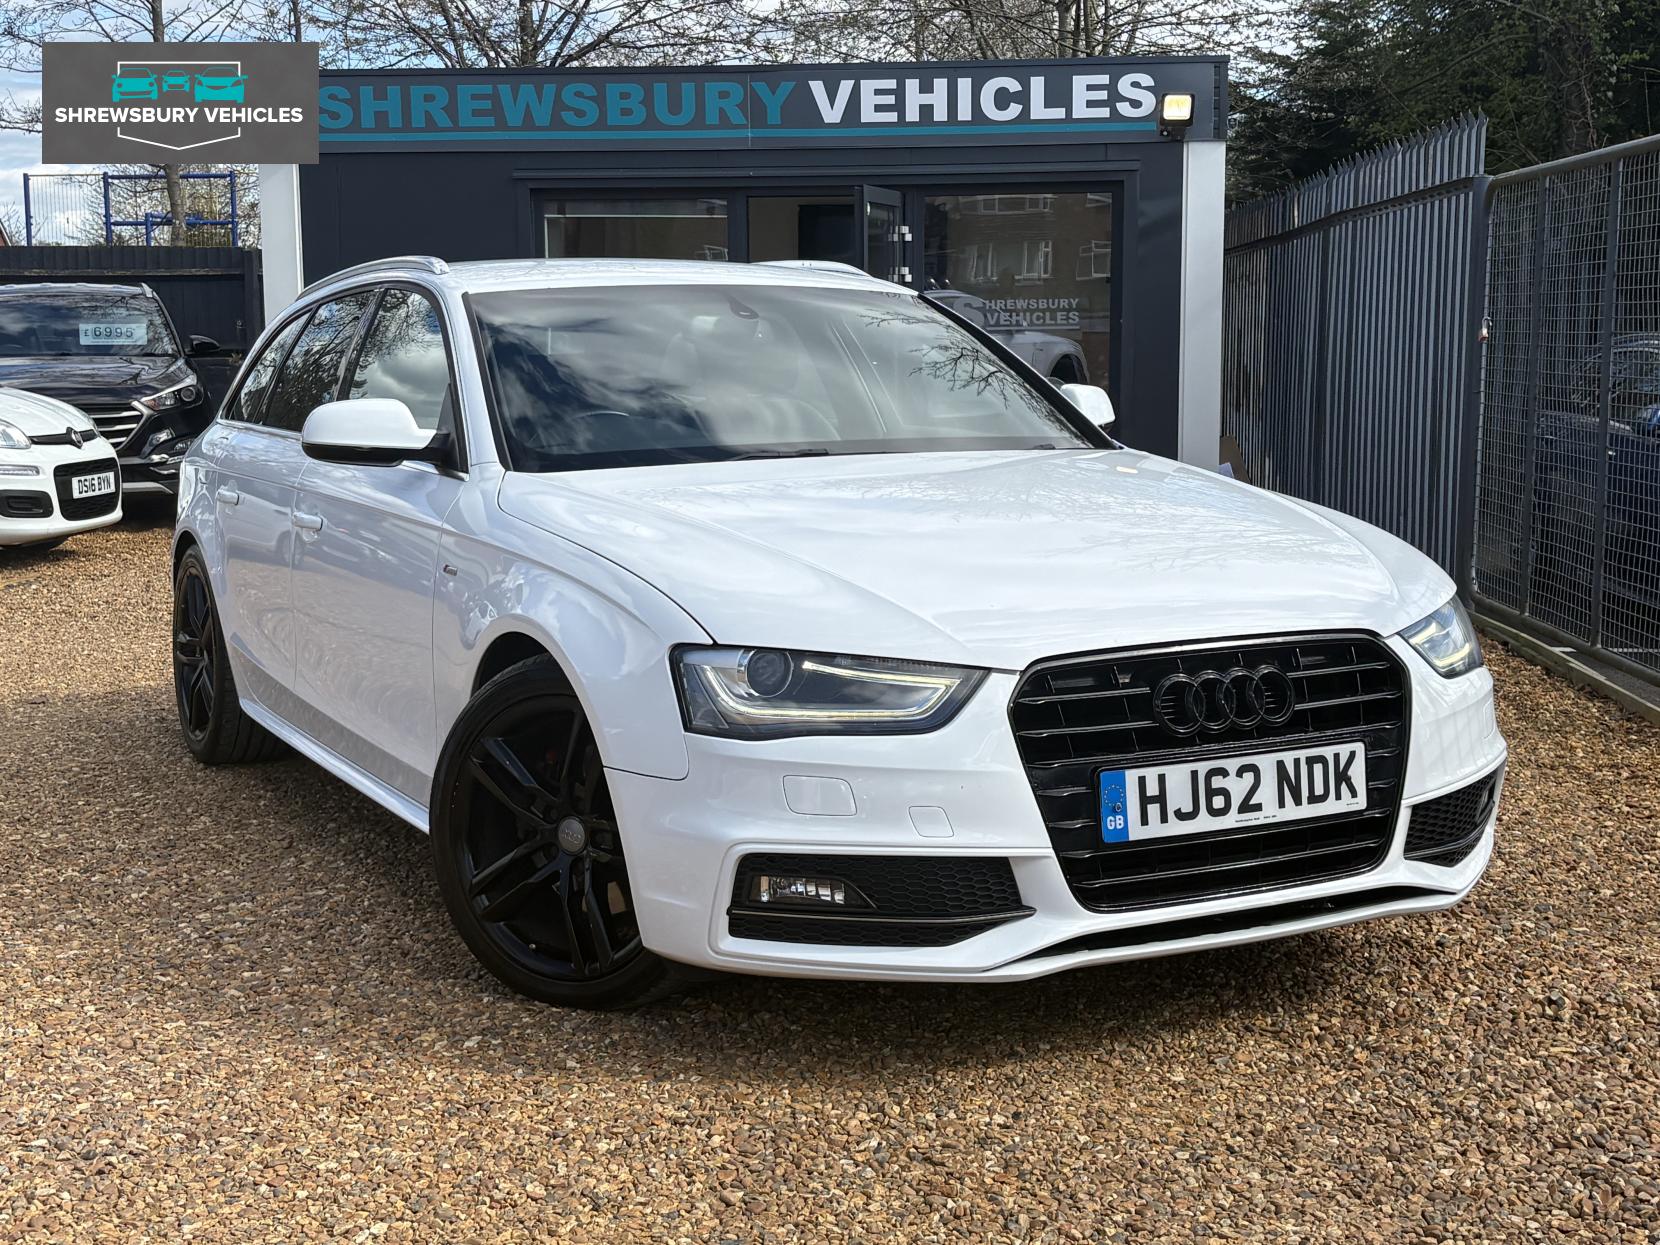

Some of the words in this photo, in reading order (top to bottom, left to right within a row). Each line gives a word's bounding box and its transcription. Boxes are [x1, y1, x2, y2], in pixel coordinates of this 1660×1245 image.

[318, 81, 796, 128] SHREWSBURY
[808, 72, 1157, 124] VEHICLES
[986, 311, 1080, 325] VEHICLES
[77, 477, 96, 495] DS16
[97, 474, 112, 492] BYN
[1137, 763, 1263, 827] HJ62
[1276, 749, 1359, 810] NDK
[1106, 815, 1125, 830] GB
